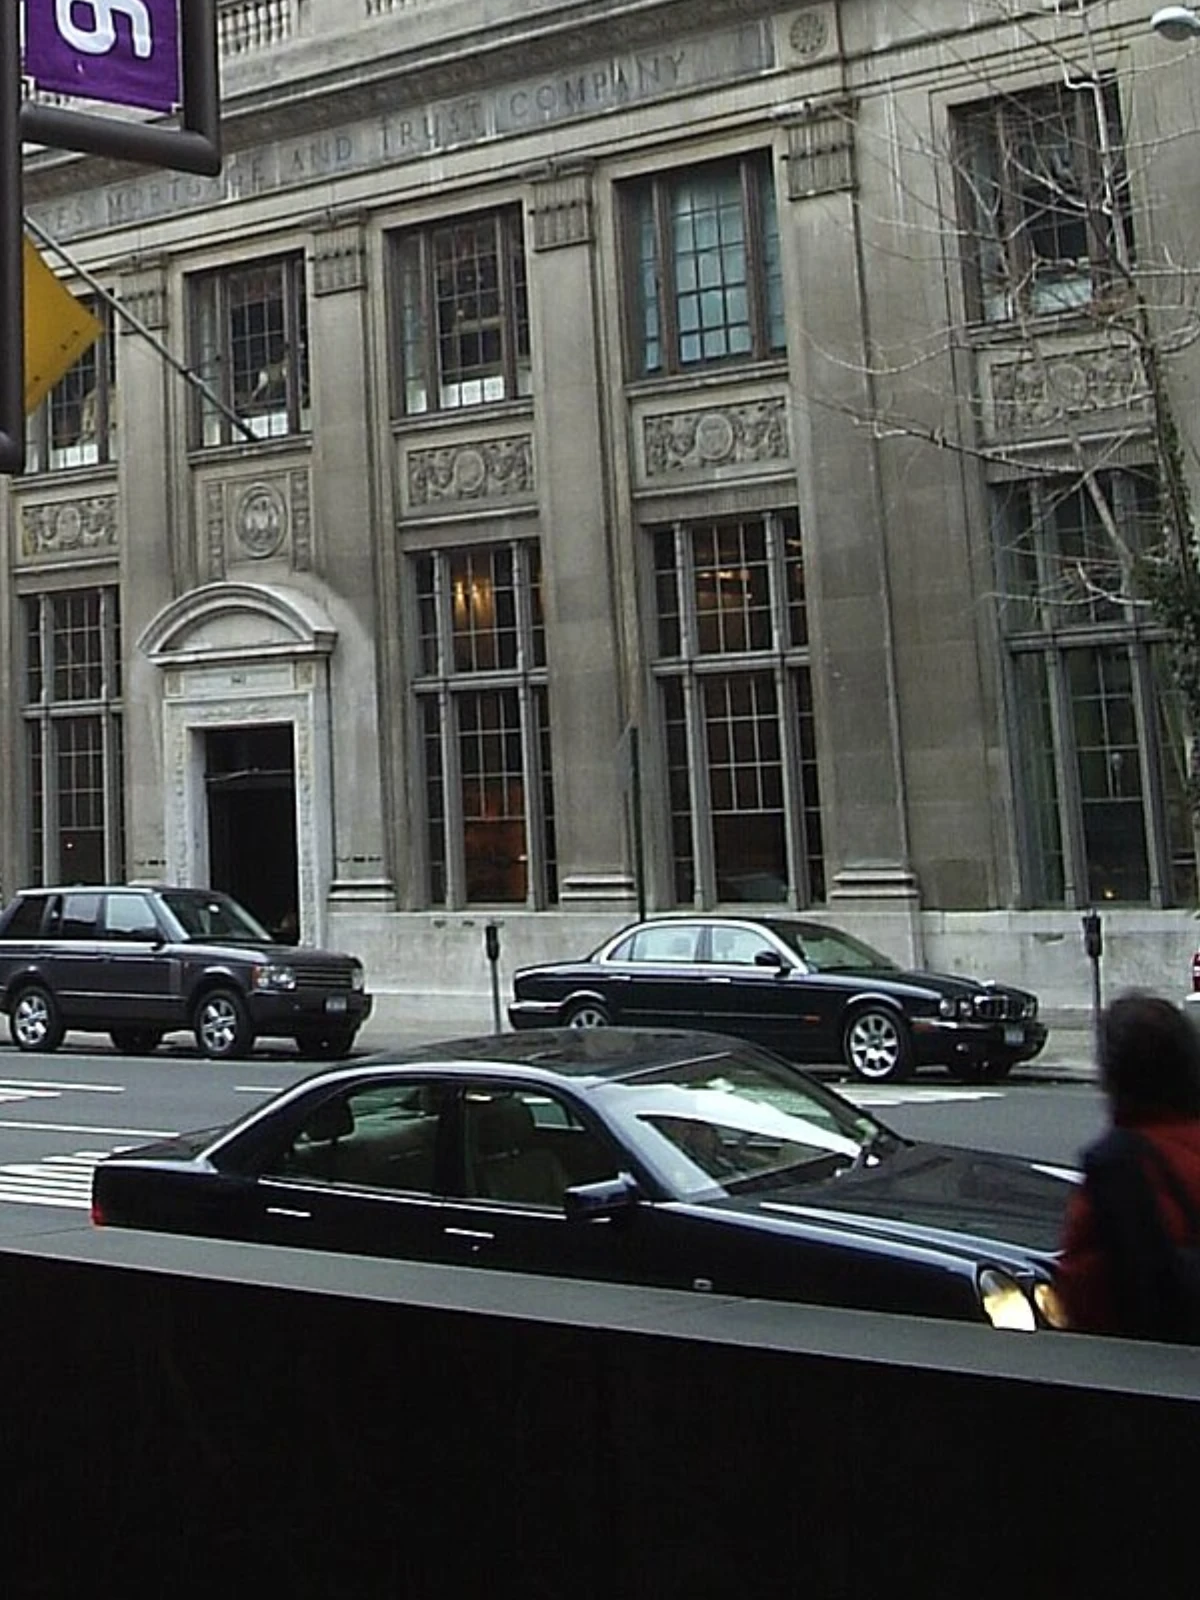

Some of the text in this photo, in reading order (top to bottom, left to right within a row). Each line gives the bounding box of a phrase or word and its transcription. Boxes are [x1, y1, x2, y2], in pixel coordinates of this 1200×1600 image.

[291, 135, 352, 172] AND
[377, 102, 482, 152] TRUST
[509, 50, 686, 118] COMPANY
